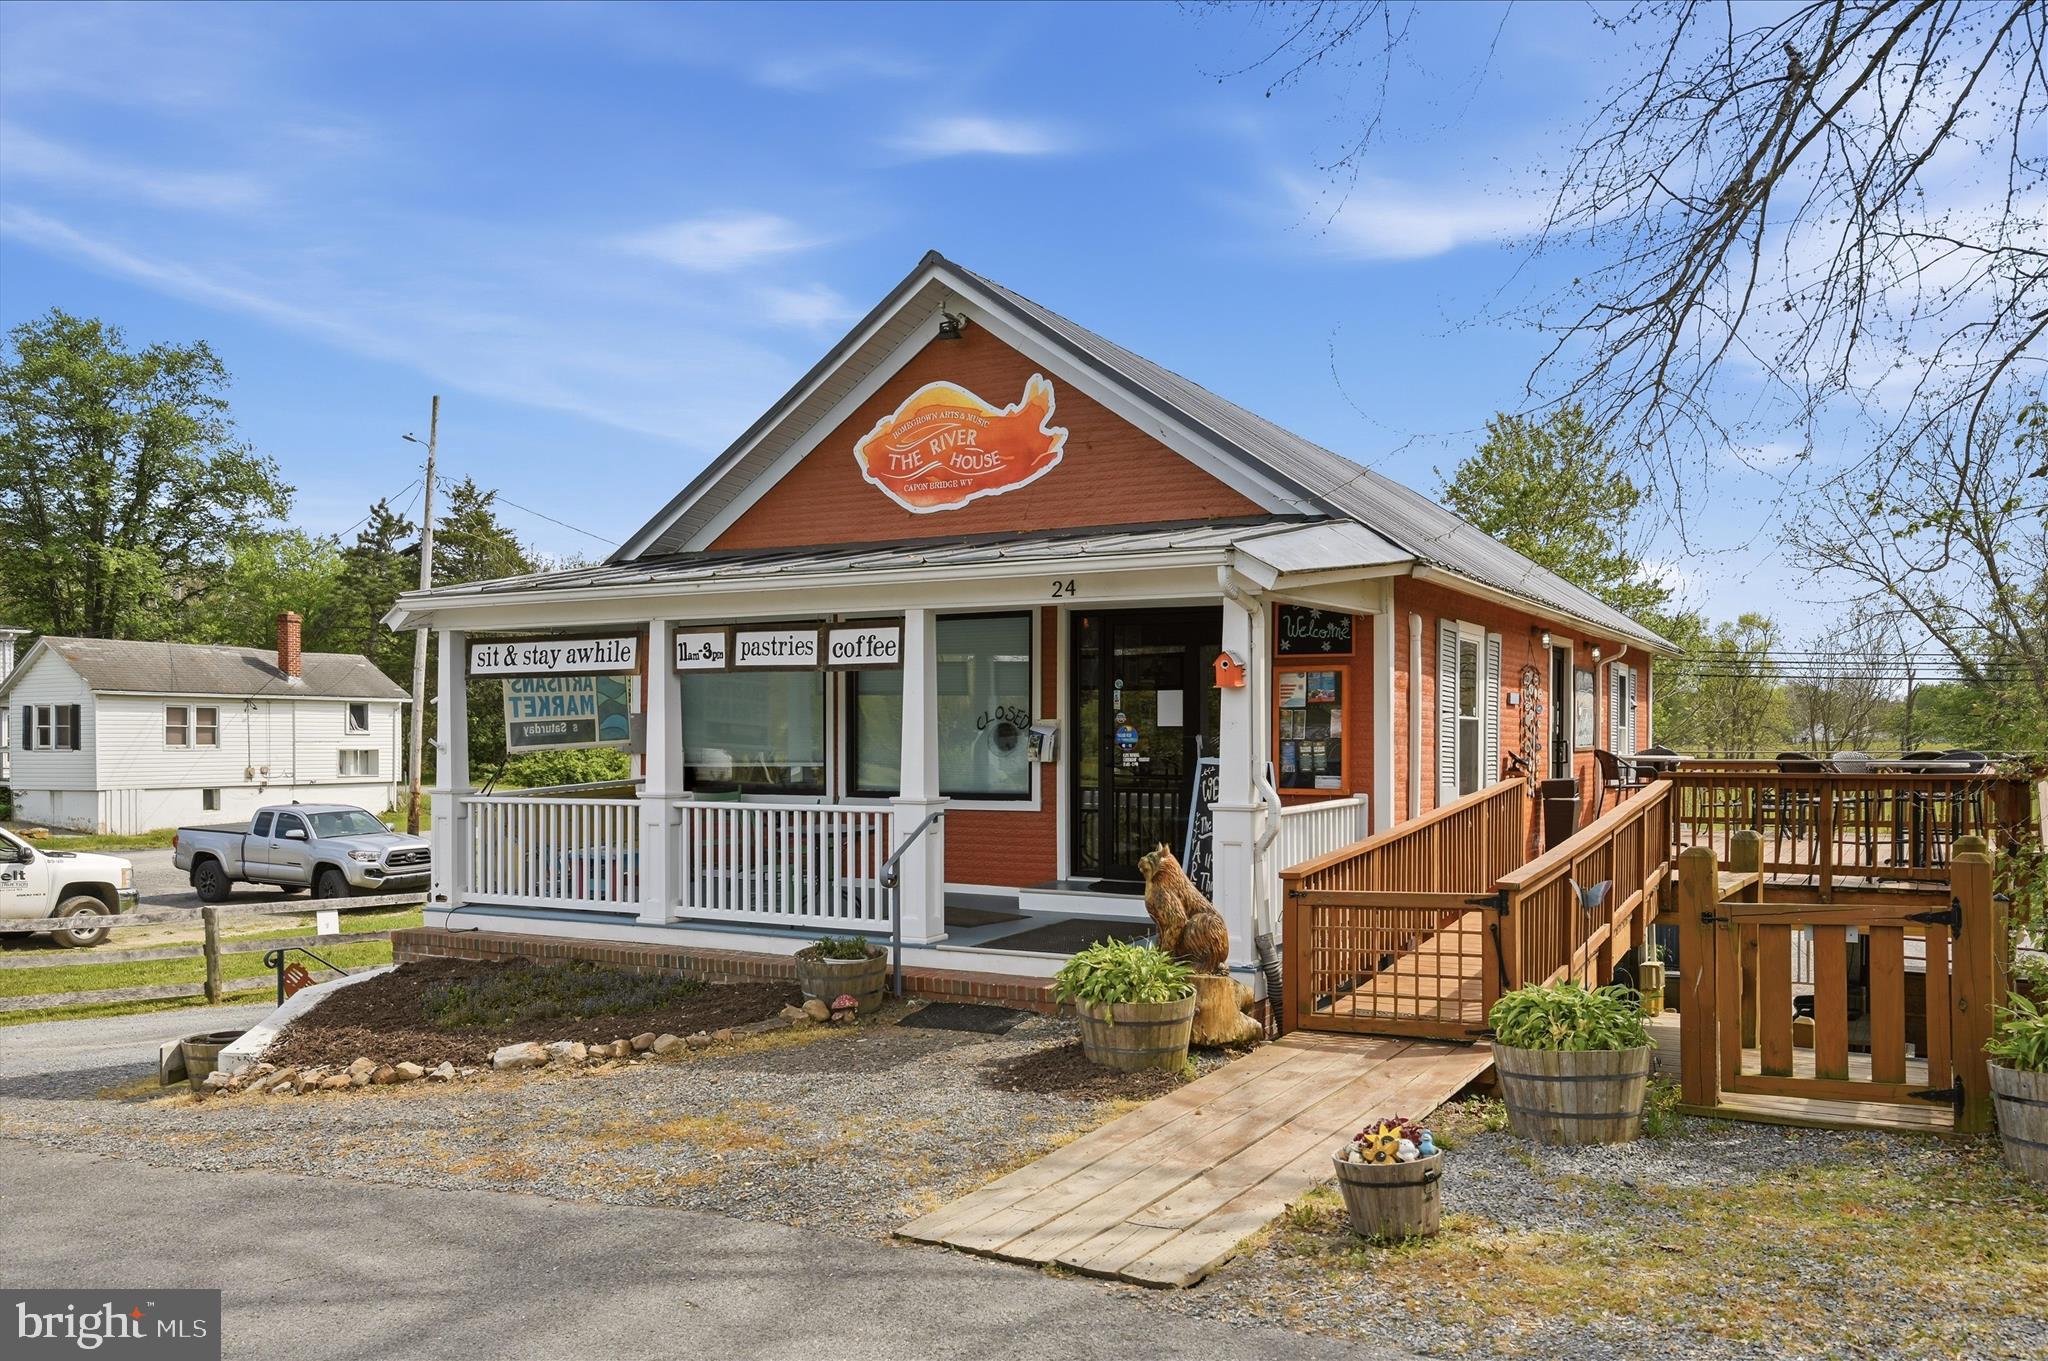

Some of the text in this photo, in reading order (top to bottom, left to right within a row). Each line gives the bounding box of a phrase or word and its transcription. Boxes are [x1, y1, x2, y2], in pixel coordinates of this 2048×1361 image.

[892, 411, 990, 439] HOMEGROWN ARTS & MUSIC
[888, 429, 1001, 470] THE RIVER HOUSE
[903, 478, 974, 492] CAPON BRIDGE WV
[1051, 579, 1076, 598] 24
[1282, 615, 1351, 640] Welcome
[477, 640, 631, 669] sit & stay awhile
[740, 635, 814, 661] pastries
[832, 634, 897, 658] coffee
[977, 705, 1031, 730] CLOSED
